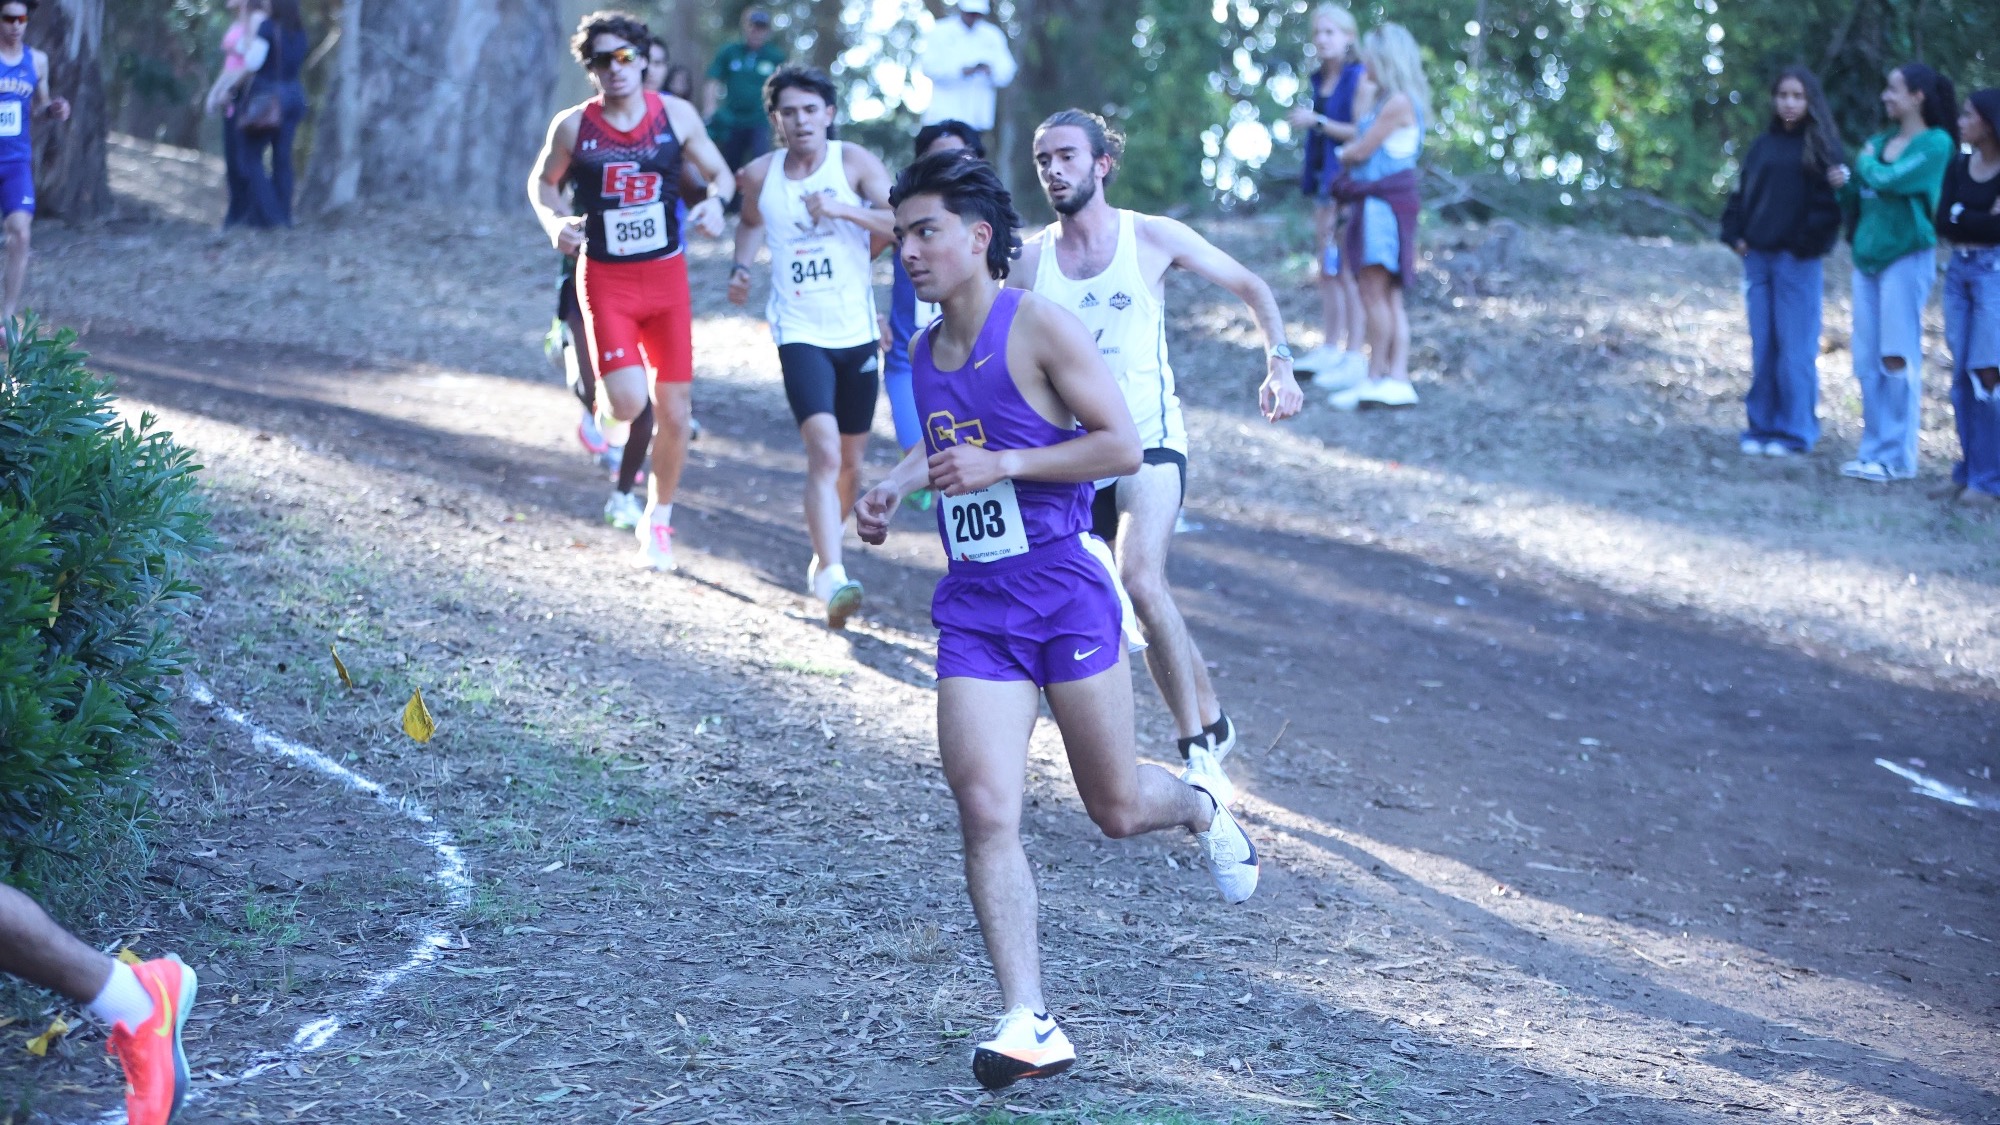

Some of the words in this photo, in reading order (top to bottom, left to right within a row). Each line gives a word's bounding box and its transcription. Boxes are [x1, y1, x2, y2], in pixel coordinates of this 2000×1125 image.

[601, 161, 663, 207] EB
[616, 218, 655, 242] 358
[791, 258, 833, 284] 344
[952, 500, 1006, 543] 203
